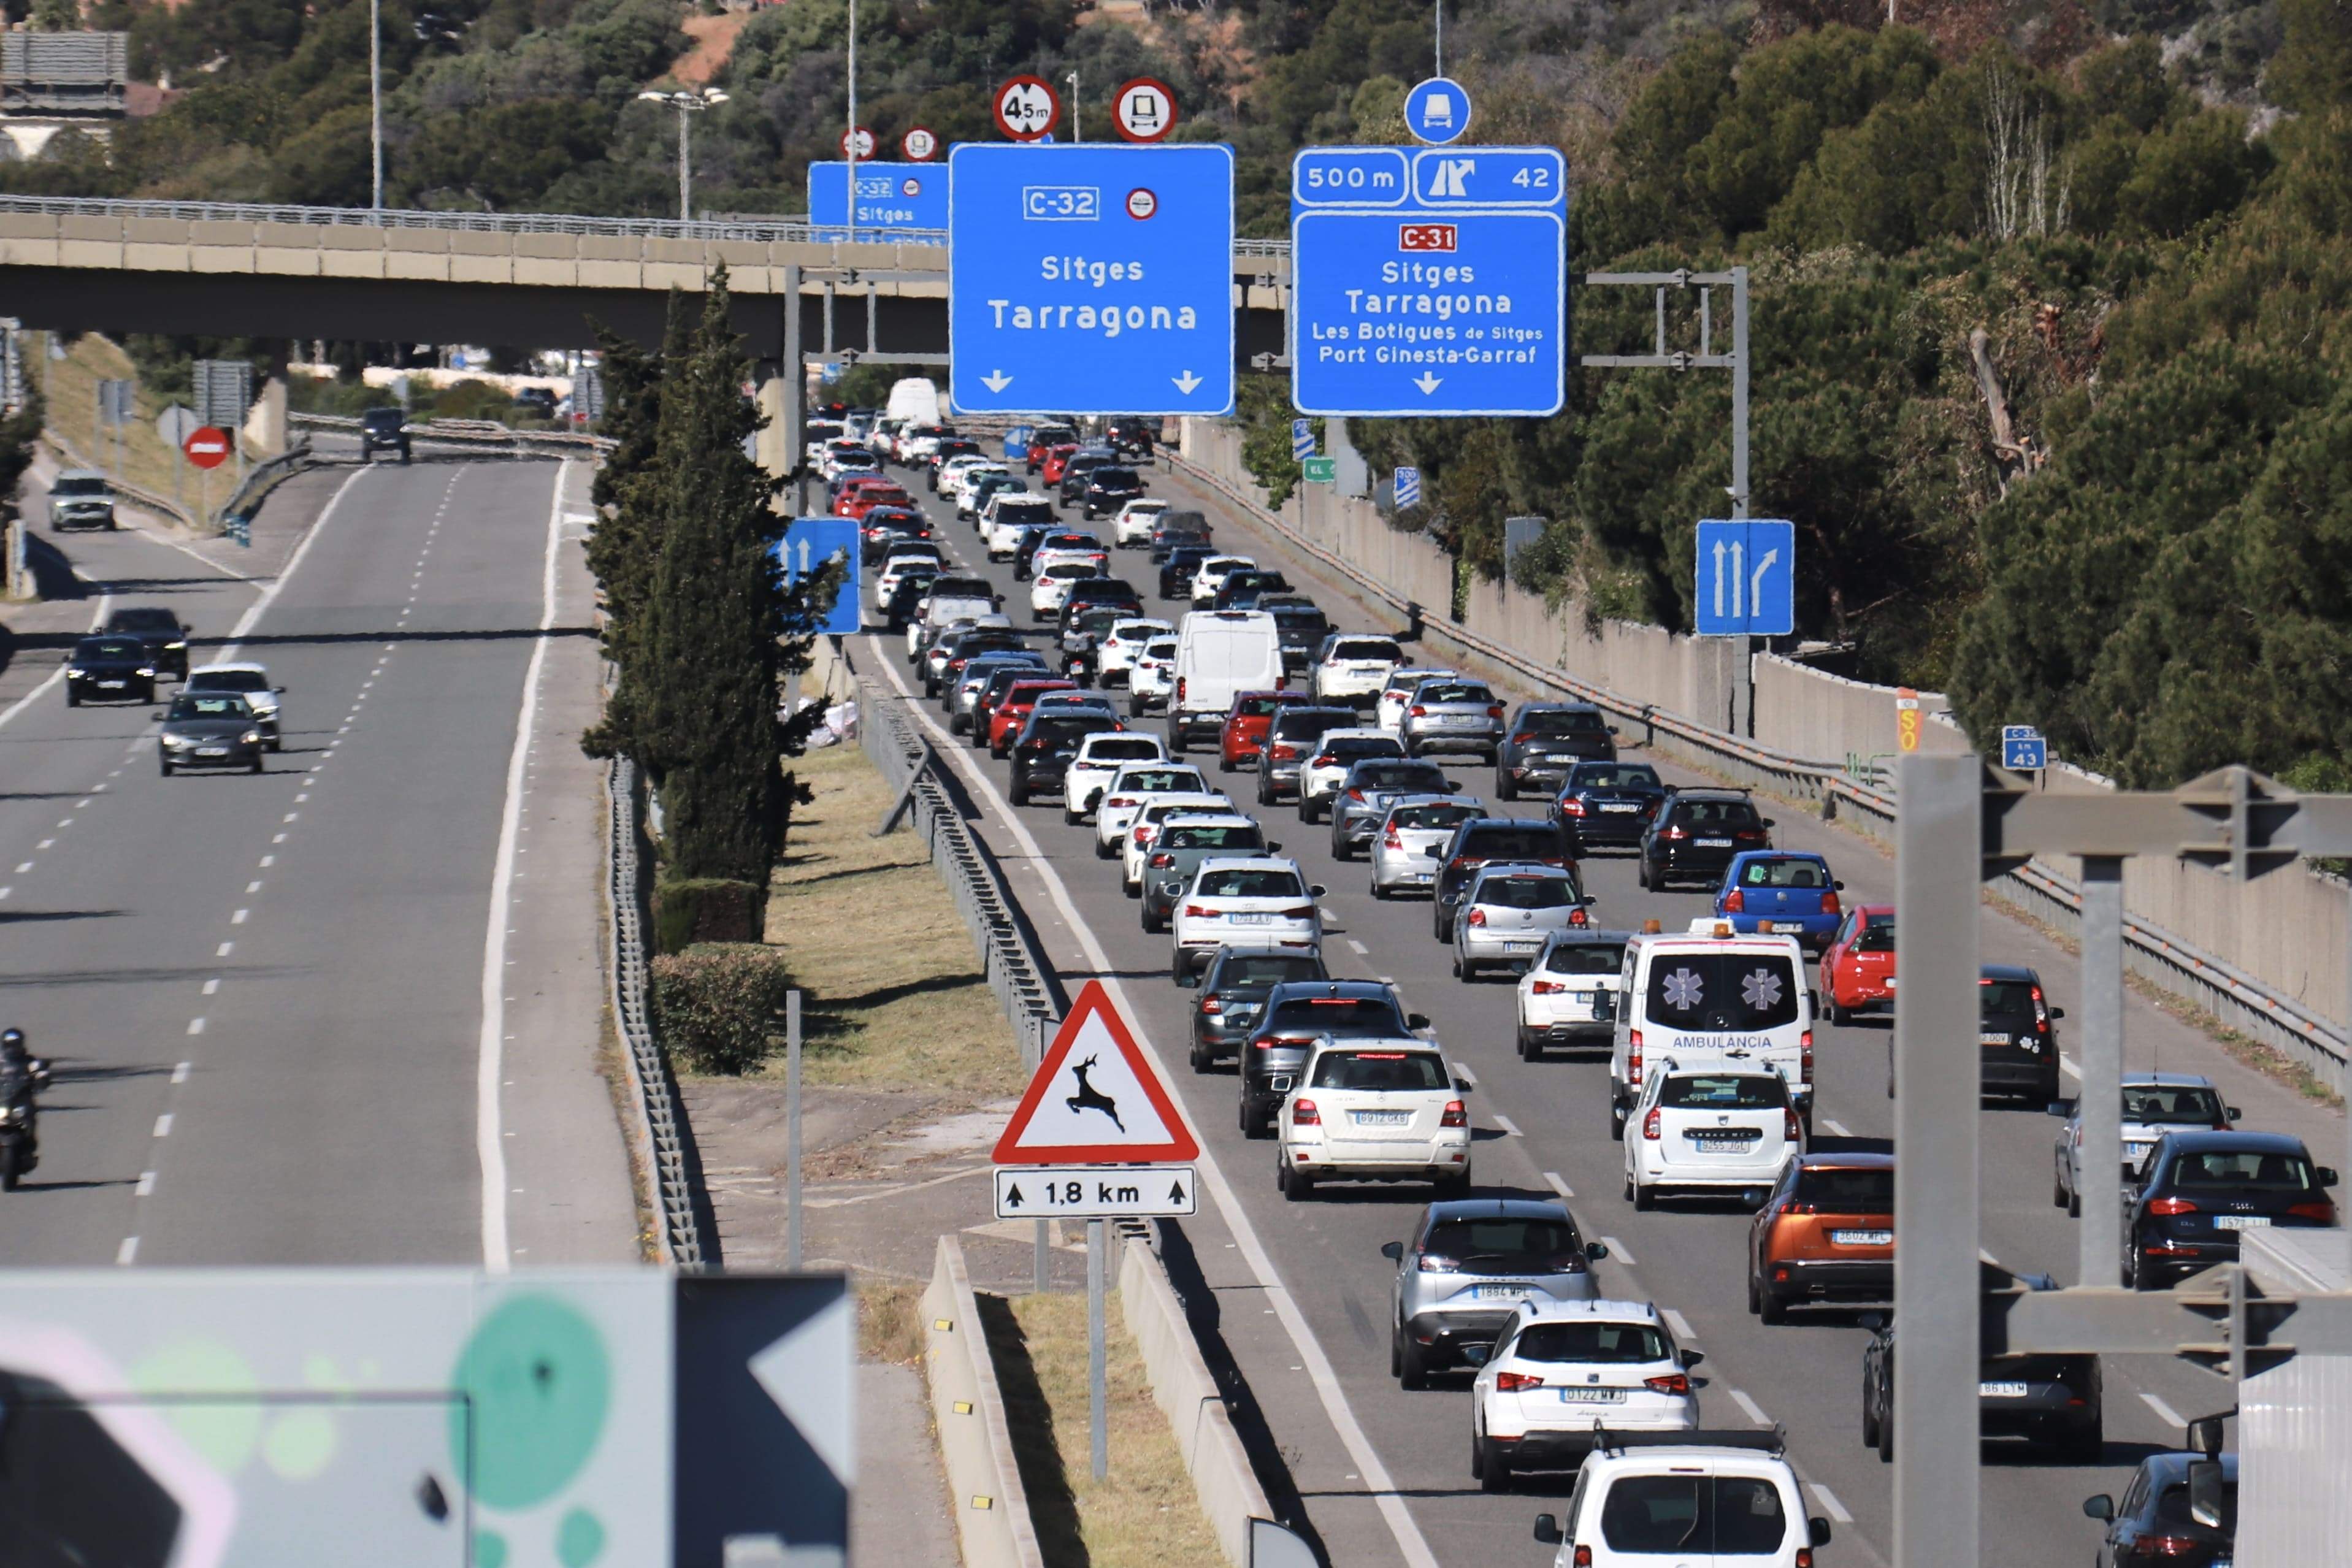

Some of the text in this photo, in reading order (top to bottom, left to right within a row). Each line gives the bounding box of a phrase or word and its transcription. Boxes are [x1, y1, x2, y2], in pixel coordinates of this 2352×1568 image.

[1309, 167, 1393, 187] 500 m
[1512, 167, 1549, 188] 42
[854, 181, 890, 194] C-32
[1030, 193, 1094, 215] C-32
[857, 207, 913, 224] Sitges
[1404, 229, 1453, 247] C-31
[1041, 256, 1143, 287] Sitges
[1382, 262, 1474, 288] Sitges
[1345, 290, 1511, 320] Tarragona
[987, 300, 1196, 337] Tarragona
[1312, 323, 1543, 343] Les Botigues de Sitges
[1319, 346, 1536, 363] Port Ginesta-Garraf
[2013, 754, 2036, 766] 43
[1673, 1034, 1772, 1048] AMBULÀNCIA
[1046, 1182, 1139, 1206] 1,8 km
[1567, 1389, 1596, 1399] 0122
